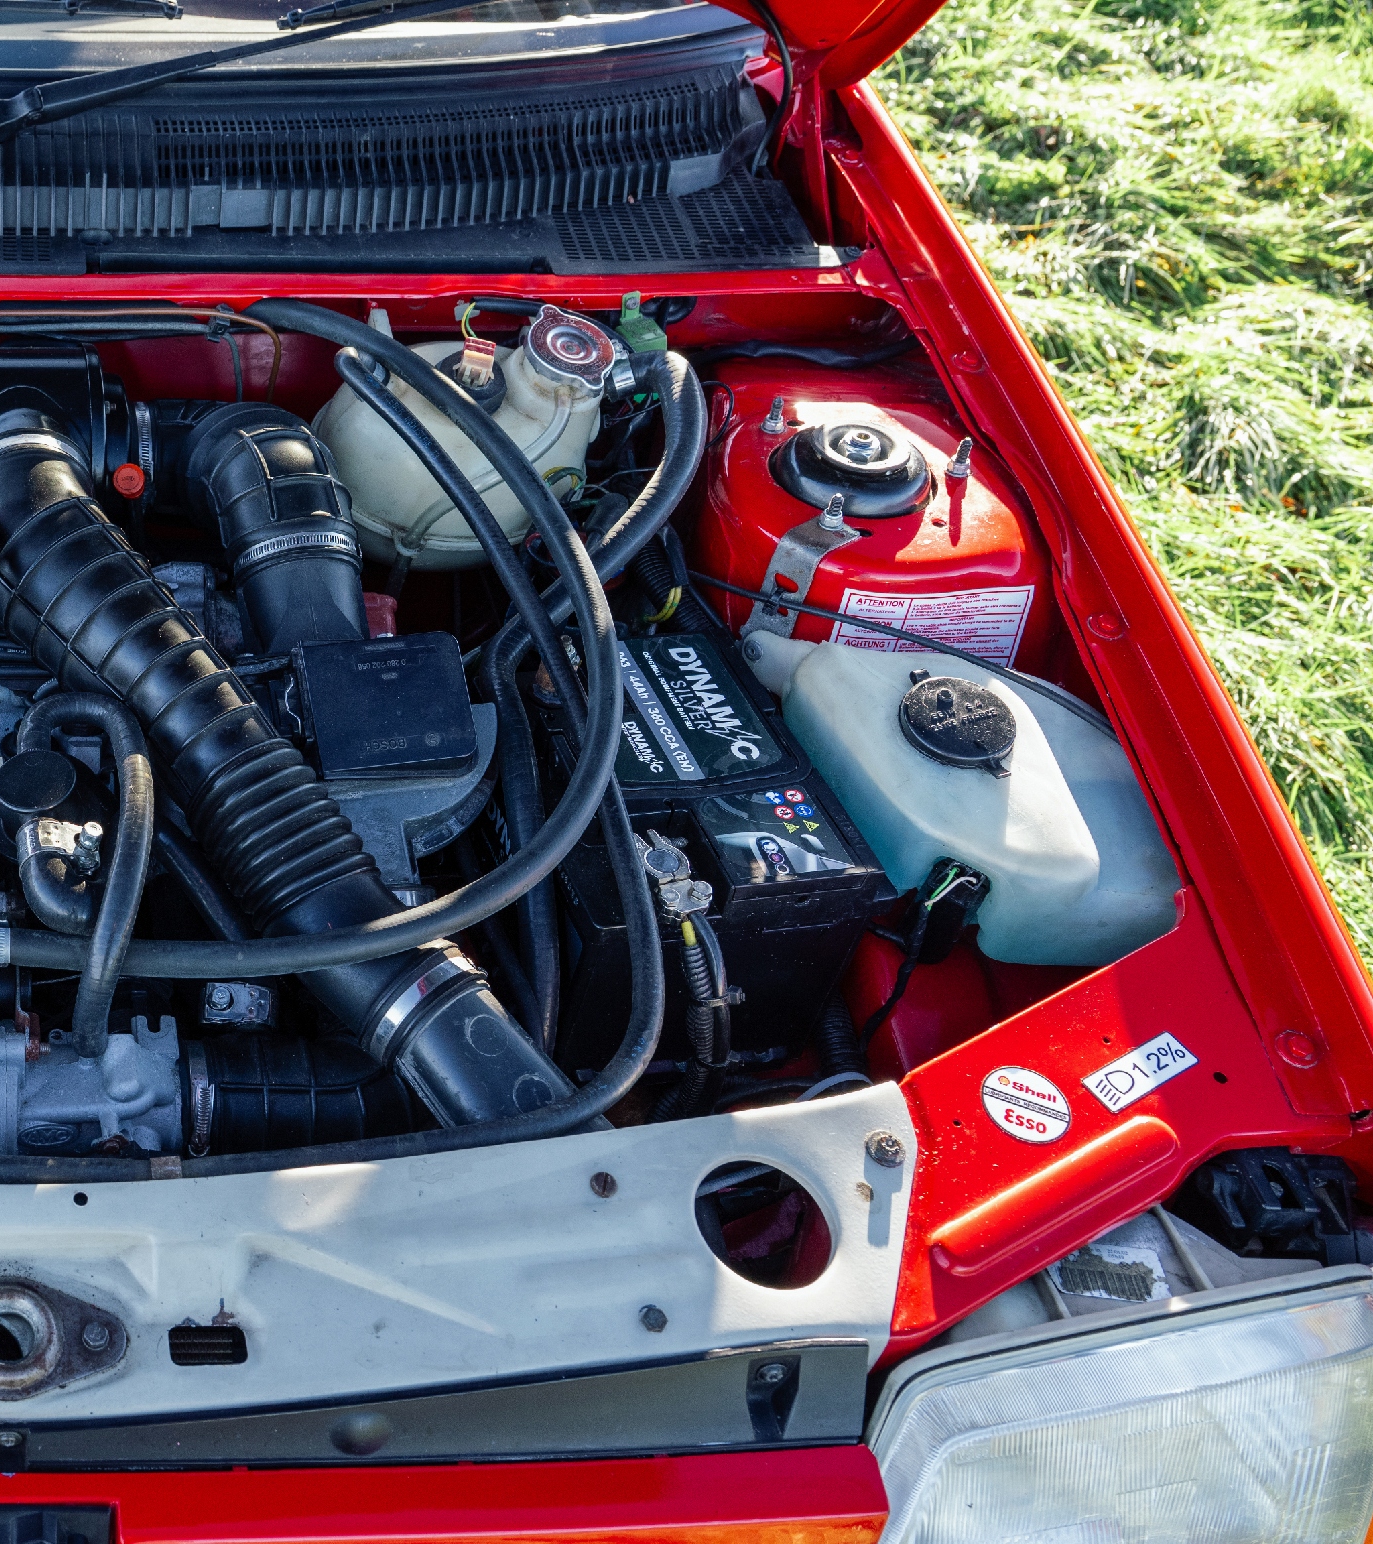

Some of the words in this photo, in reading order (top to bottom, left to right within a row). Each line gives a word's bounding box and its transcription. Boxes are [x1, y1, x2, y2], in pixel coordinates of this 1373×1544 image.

[856, 597, 905, 608] ATTENTION
[844, 639, 886, 649] ACHTUNG
[671, 680, 712, 730] SILVER
[364, 738, 407, 751] BOSCH
[660, 726, 680, 750] CCA
[1132, 1042, 1186, 1079] 1.2%
[1012, 1080, 1057, 1104] Shell
[1003, 1108, 1047, 1134] Esso
